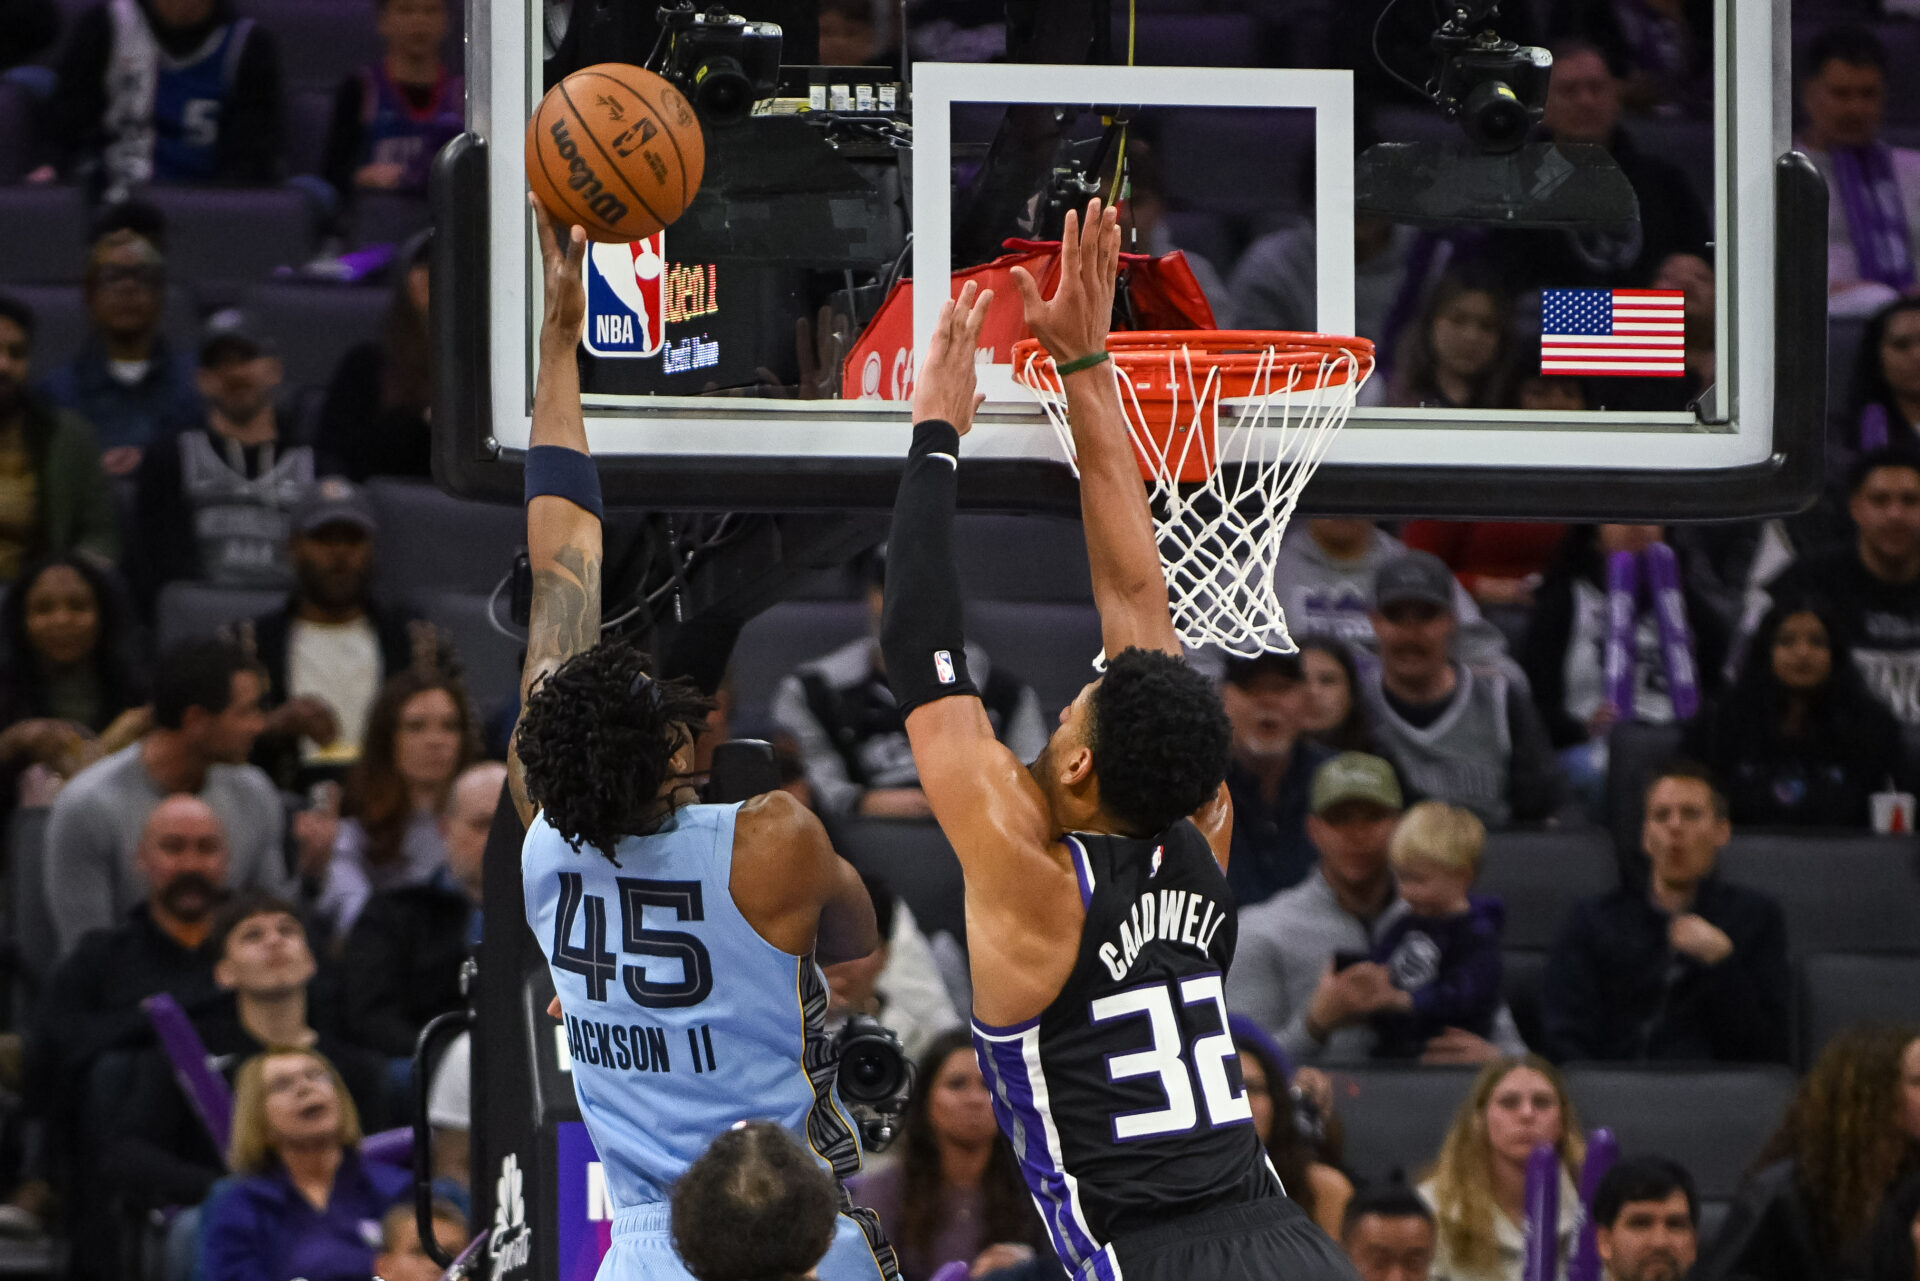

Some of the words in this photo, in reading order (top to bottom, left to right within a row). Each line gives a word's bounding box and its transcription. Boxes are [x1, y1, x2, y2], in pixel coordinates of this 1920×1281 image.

[551, 117, 629, 226] Wilson
[596, 314, 635, 344] NBA
[551, 871, 714, 1009] 45
[686, 1023, 717, 1074] II
[1089, 971, 1254, 1144] 32
